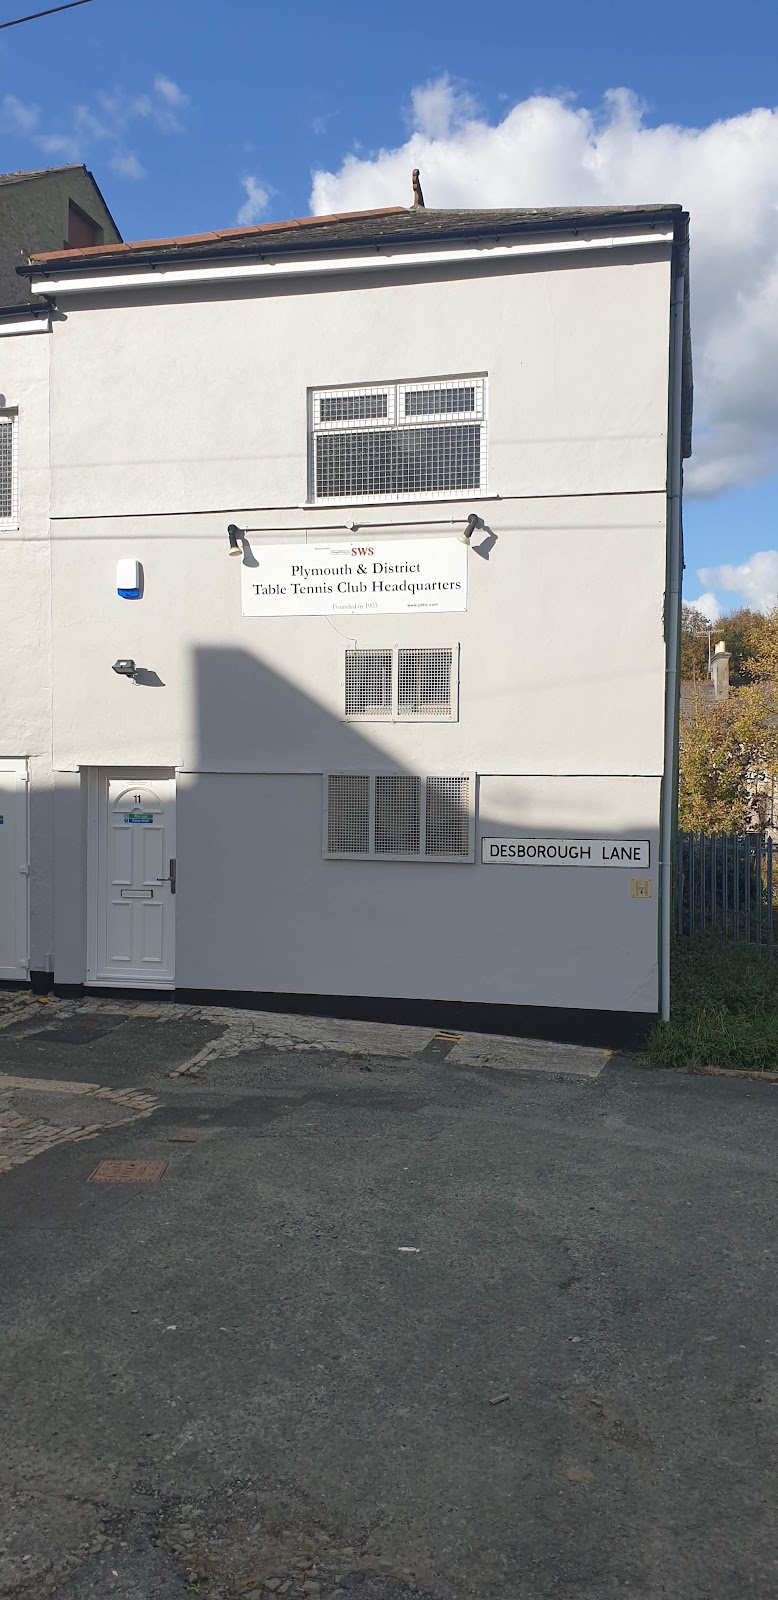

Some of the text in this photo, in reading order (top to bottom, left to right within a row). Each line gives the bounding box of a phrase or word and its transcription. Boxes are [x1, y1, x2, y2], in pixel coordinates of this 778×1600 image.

[351, 547, 374, 556] SWS
[291, 562, 421, 579] Plymouth & District
[253, 580, 461, 596] Table Tennis Club Headquarters
[133, 795, 141, 803] 11
[490, 844, 641, 860] DESBOROUGH LANE
